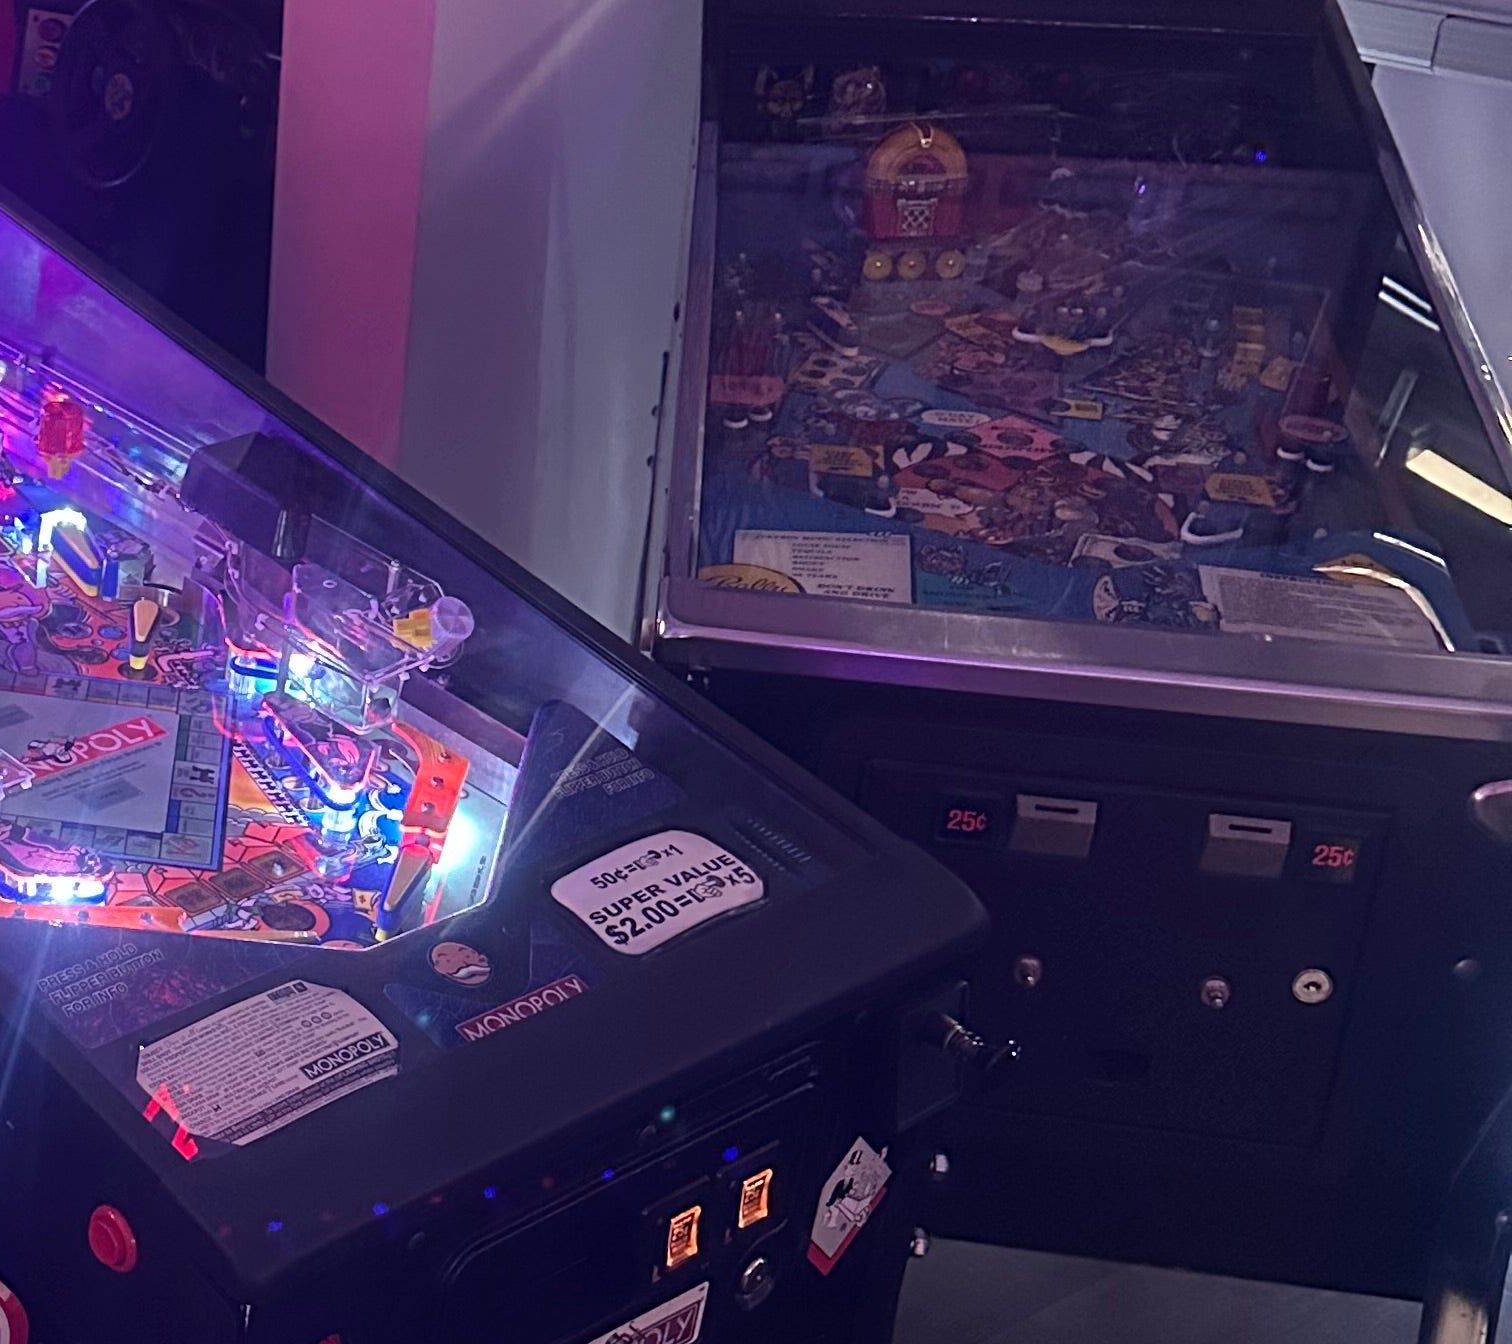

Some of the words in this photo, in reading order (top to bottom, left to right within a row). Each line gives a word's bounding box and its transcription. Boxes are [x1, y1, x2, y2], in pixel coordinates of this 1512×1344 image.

[947, 809, 987, 834] 25¢
[1312, 844, 1355, 869] 25¢
[589, 884, 664, 926] SUPER
[664, 853, 738, 888] VALUE
[38, 963, 86, 993] PRESS
[97, 943, 139, 967] HOLD
[49, 972, 107, 1005] FLIPPER
[107, 948, 166, 979] BUTTON
[62, 997, 92, 1017] FOR
[91, 982, 129, 1008] INFO
[464, 978, 583, 1041] MONOPOLY
[304, 1033, 385, 1080] MONOPOLY
